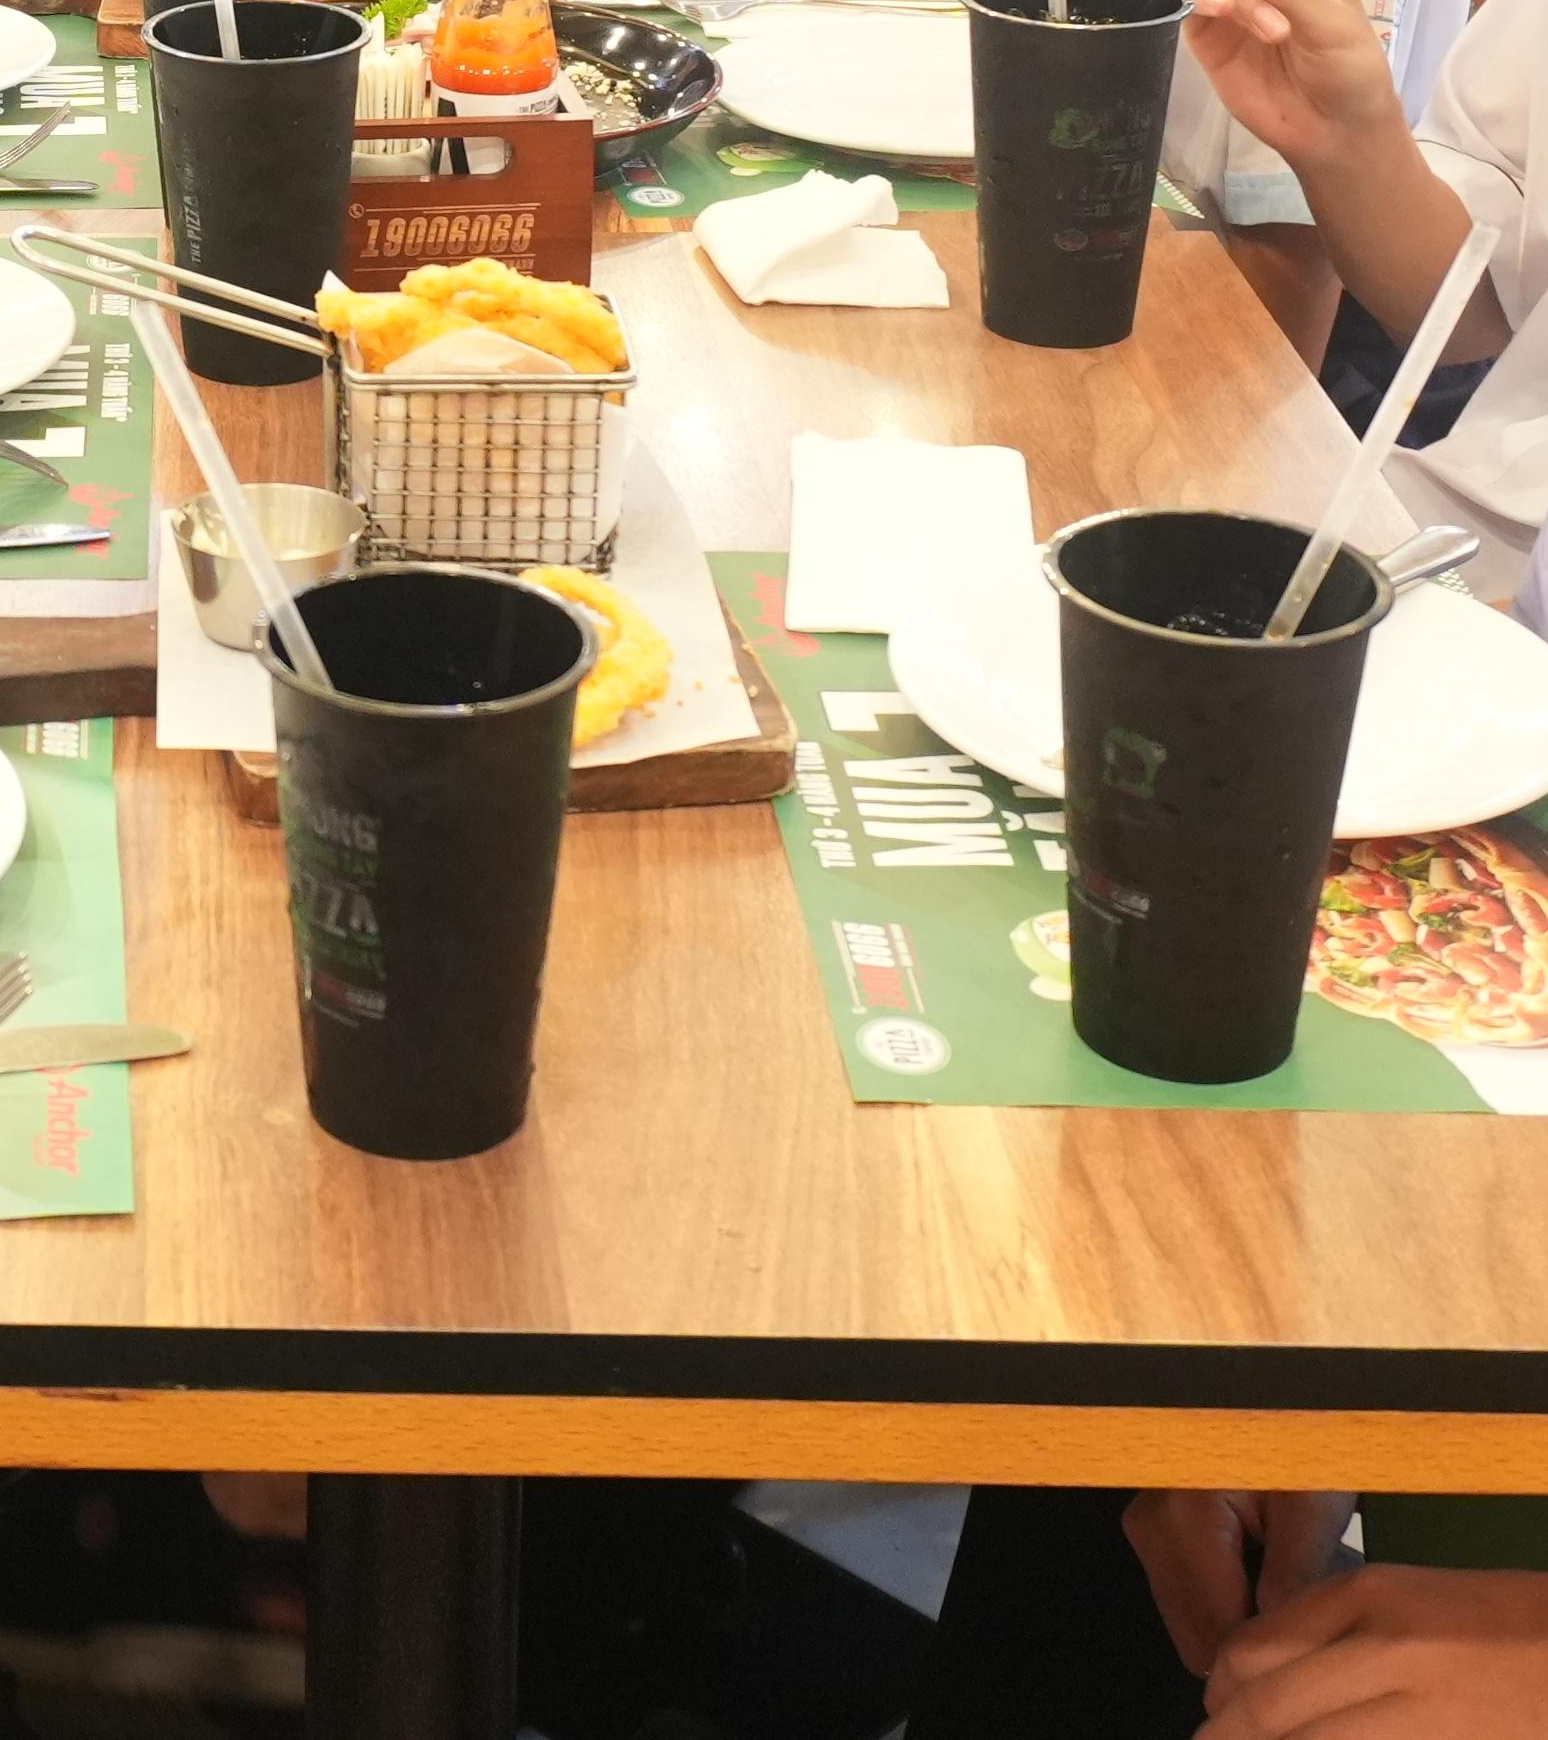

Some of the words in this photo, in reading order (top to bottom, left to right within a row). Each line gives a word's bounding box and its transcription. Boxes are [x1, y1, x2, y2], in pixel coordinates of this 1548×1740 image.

[183, 194, 203, 241] PIZZA
[360, 212, 535, 258] 19006066
[190, 239, 202, 263] THE
[842, 753, 1015, 867] MUA
[46, 1079, 84, 1179] Anchor
